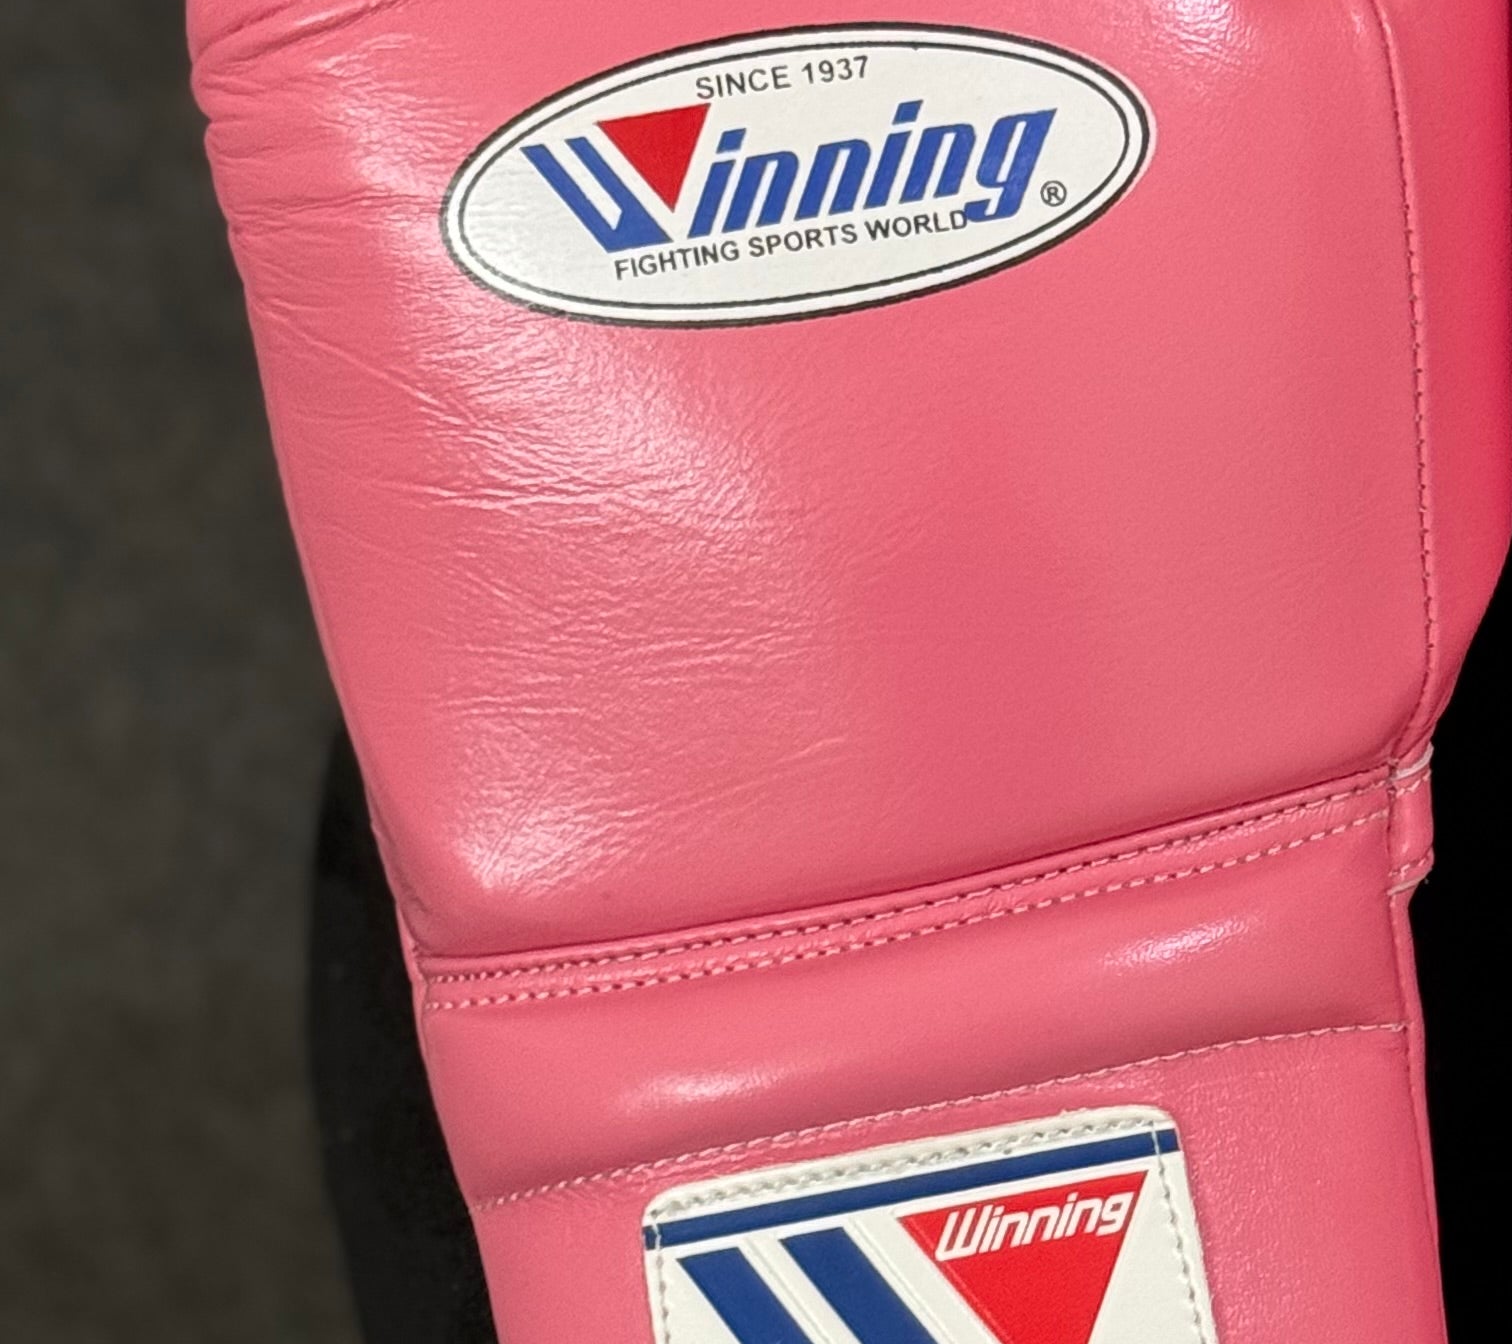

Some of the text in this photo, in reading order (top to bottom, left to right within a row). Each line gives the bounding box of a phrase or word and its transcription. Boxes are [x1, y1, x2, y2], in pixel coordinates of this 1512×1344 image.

[695, 55, 870, 101] SINCE 1937
[520, 99, 1058, 254] Winning
[614, 209, 968, 282] FIGHTING SPORTS WORLD
[934, 1191, 1135, 1262] Winning
